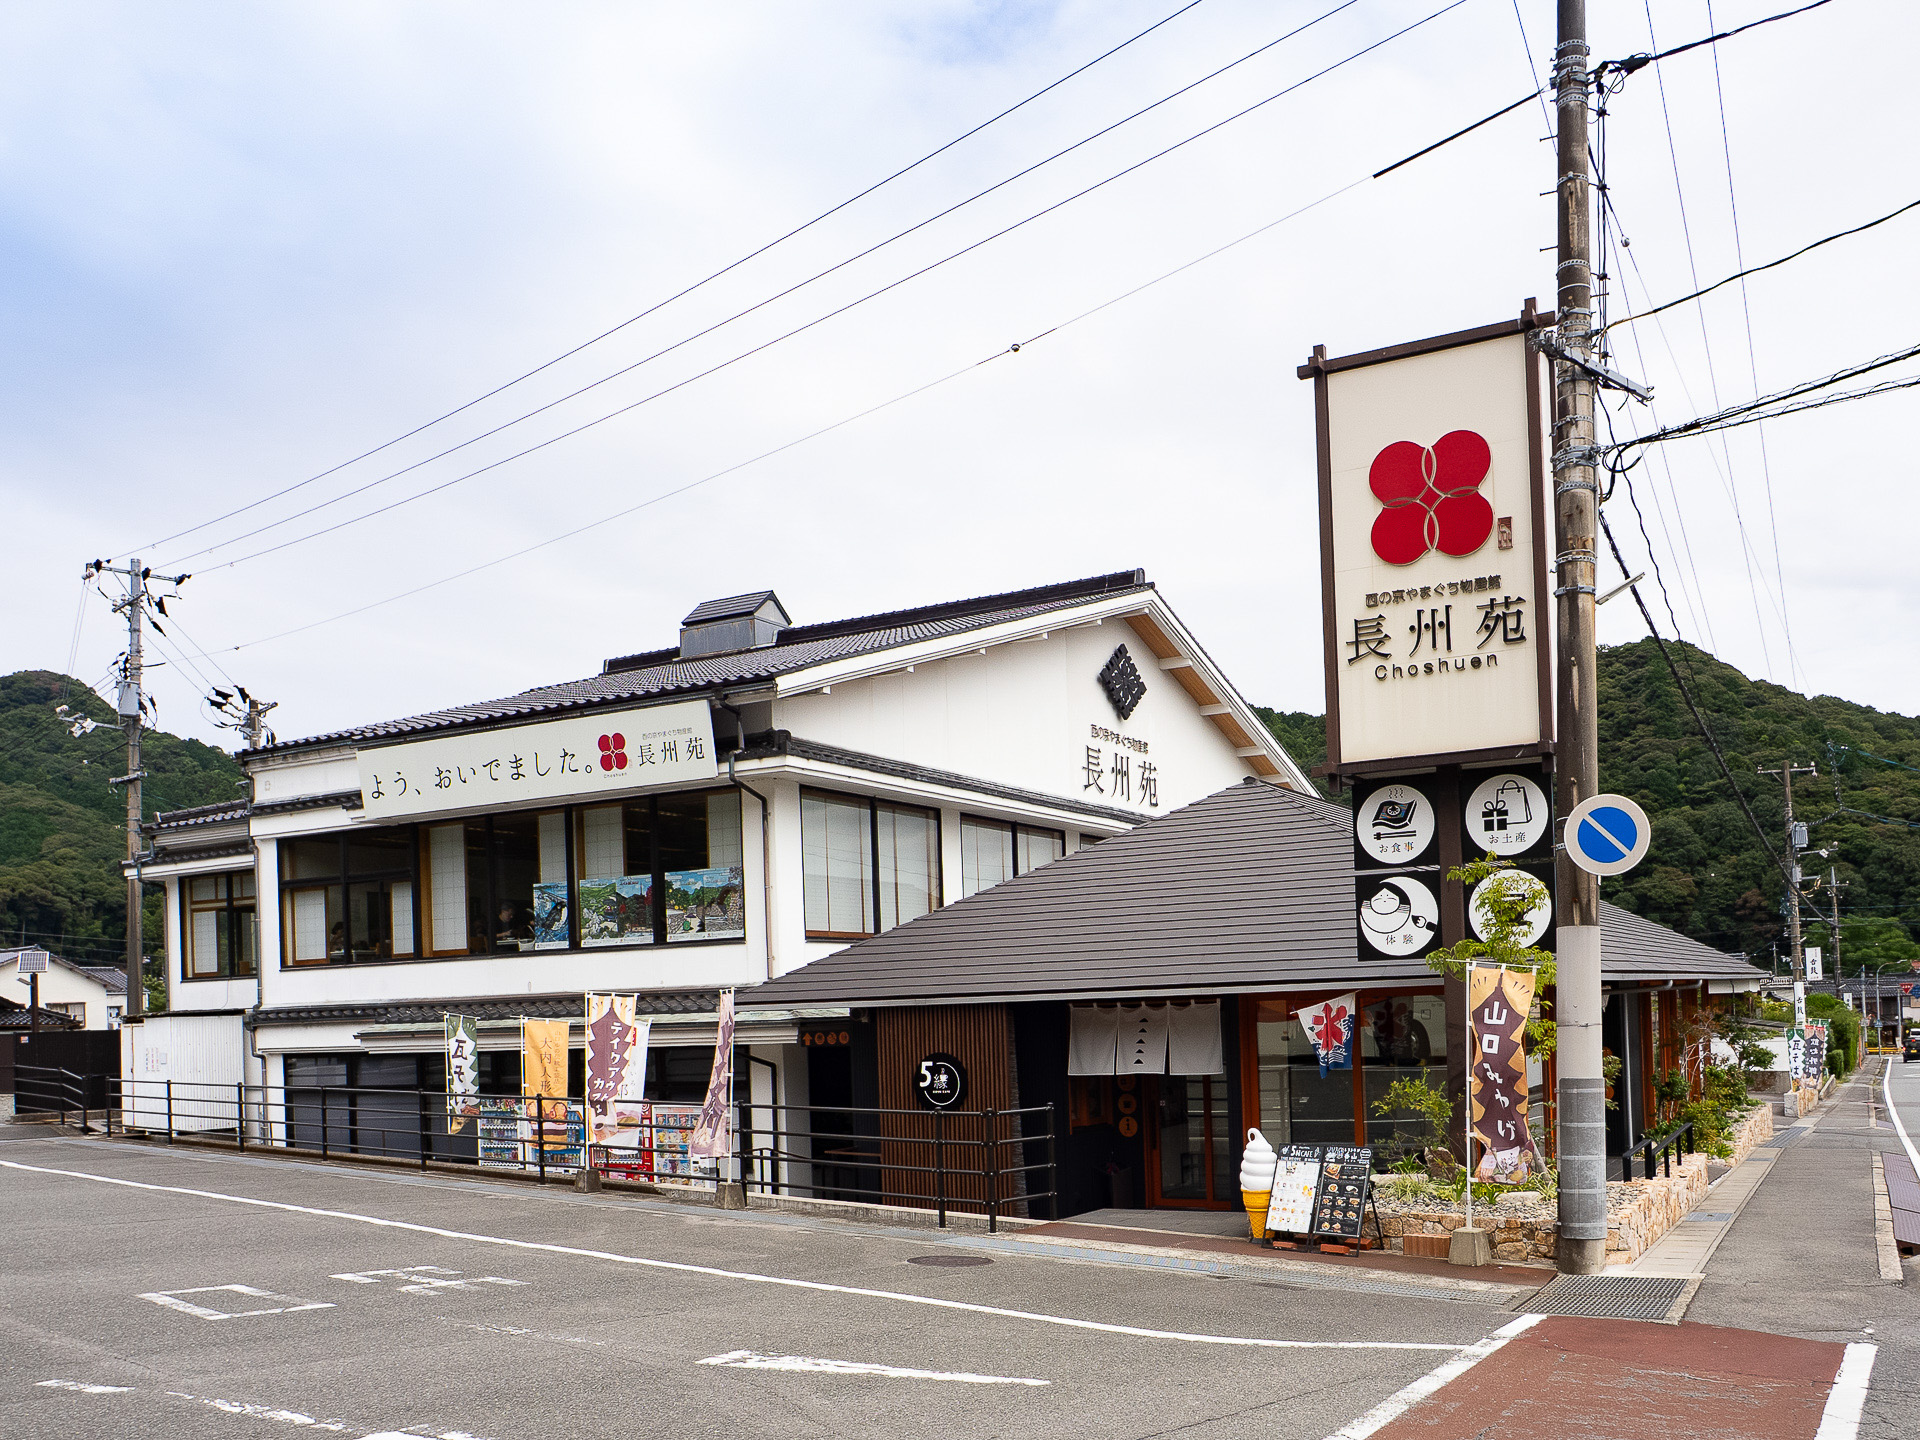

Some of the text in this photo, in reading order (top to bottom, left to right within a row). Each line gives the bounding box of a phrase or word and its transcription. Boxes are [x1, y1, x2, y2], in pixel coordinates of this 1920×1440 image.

[1345, 595, 1527, 666] 長州苑
[1374, 653, 1499, 681] Choshuen
[370, 747, 594, 800] よう、おいでました。
[637, 737, 705, 767] 長州苑
[1082, 745, 1159, 807] 長州苑
[1379, 841, 1414, 853] お食事
[1487, 831, 1527, 845] お土産
[1311, 1002, 1348, 1052] 氷
[539, 1036, 553, 1093] 大内人形
